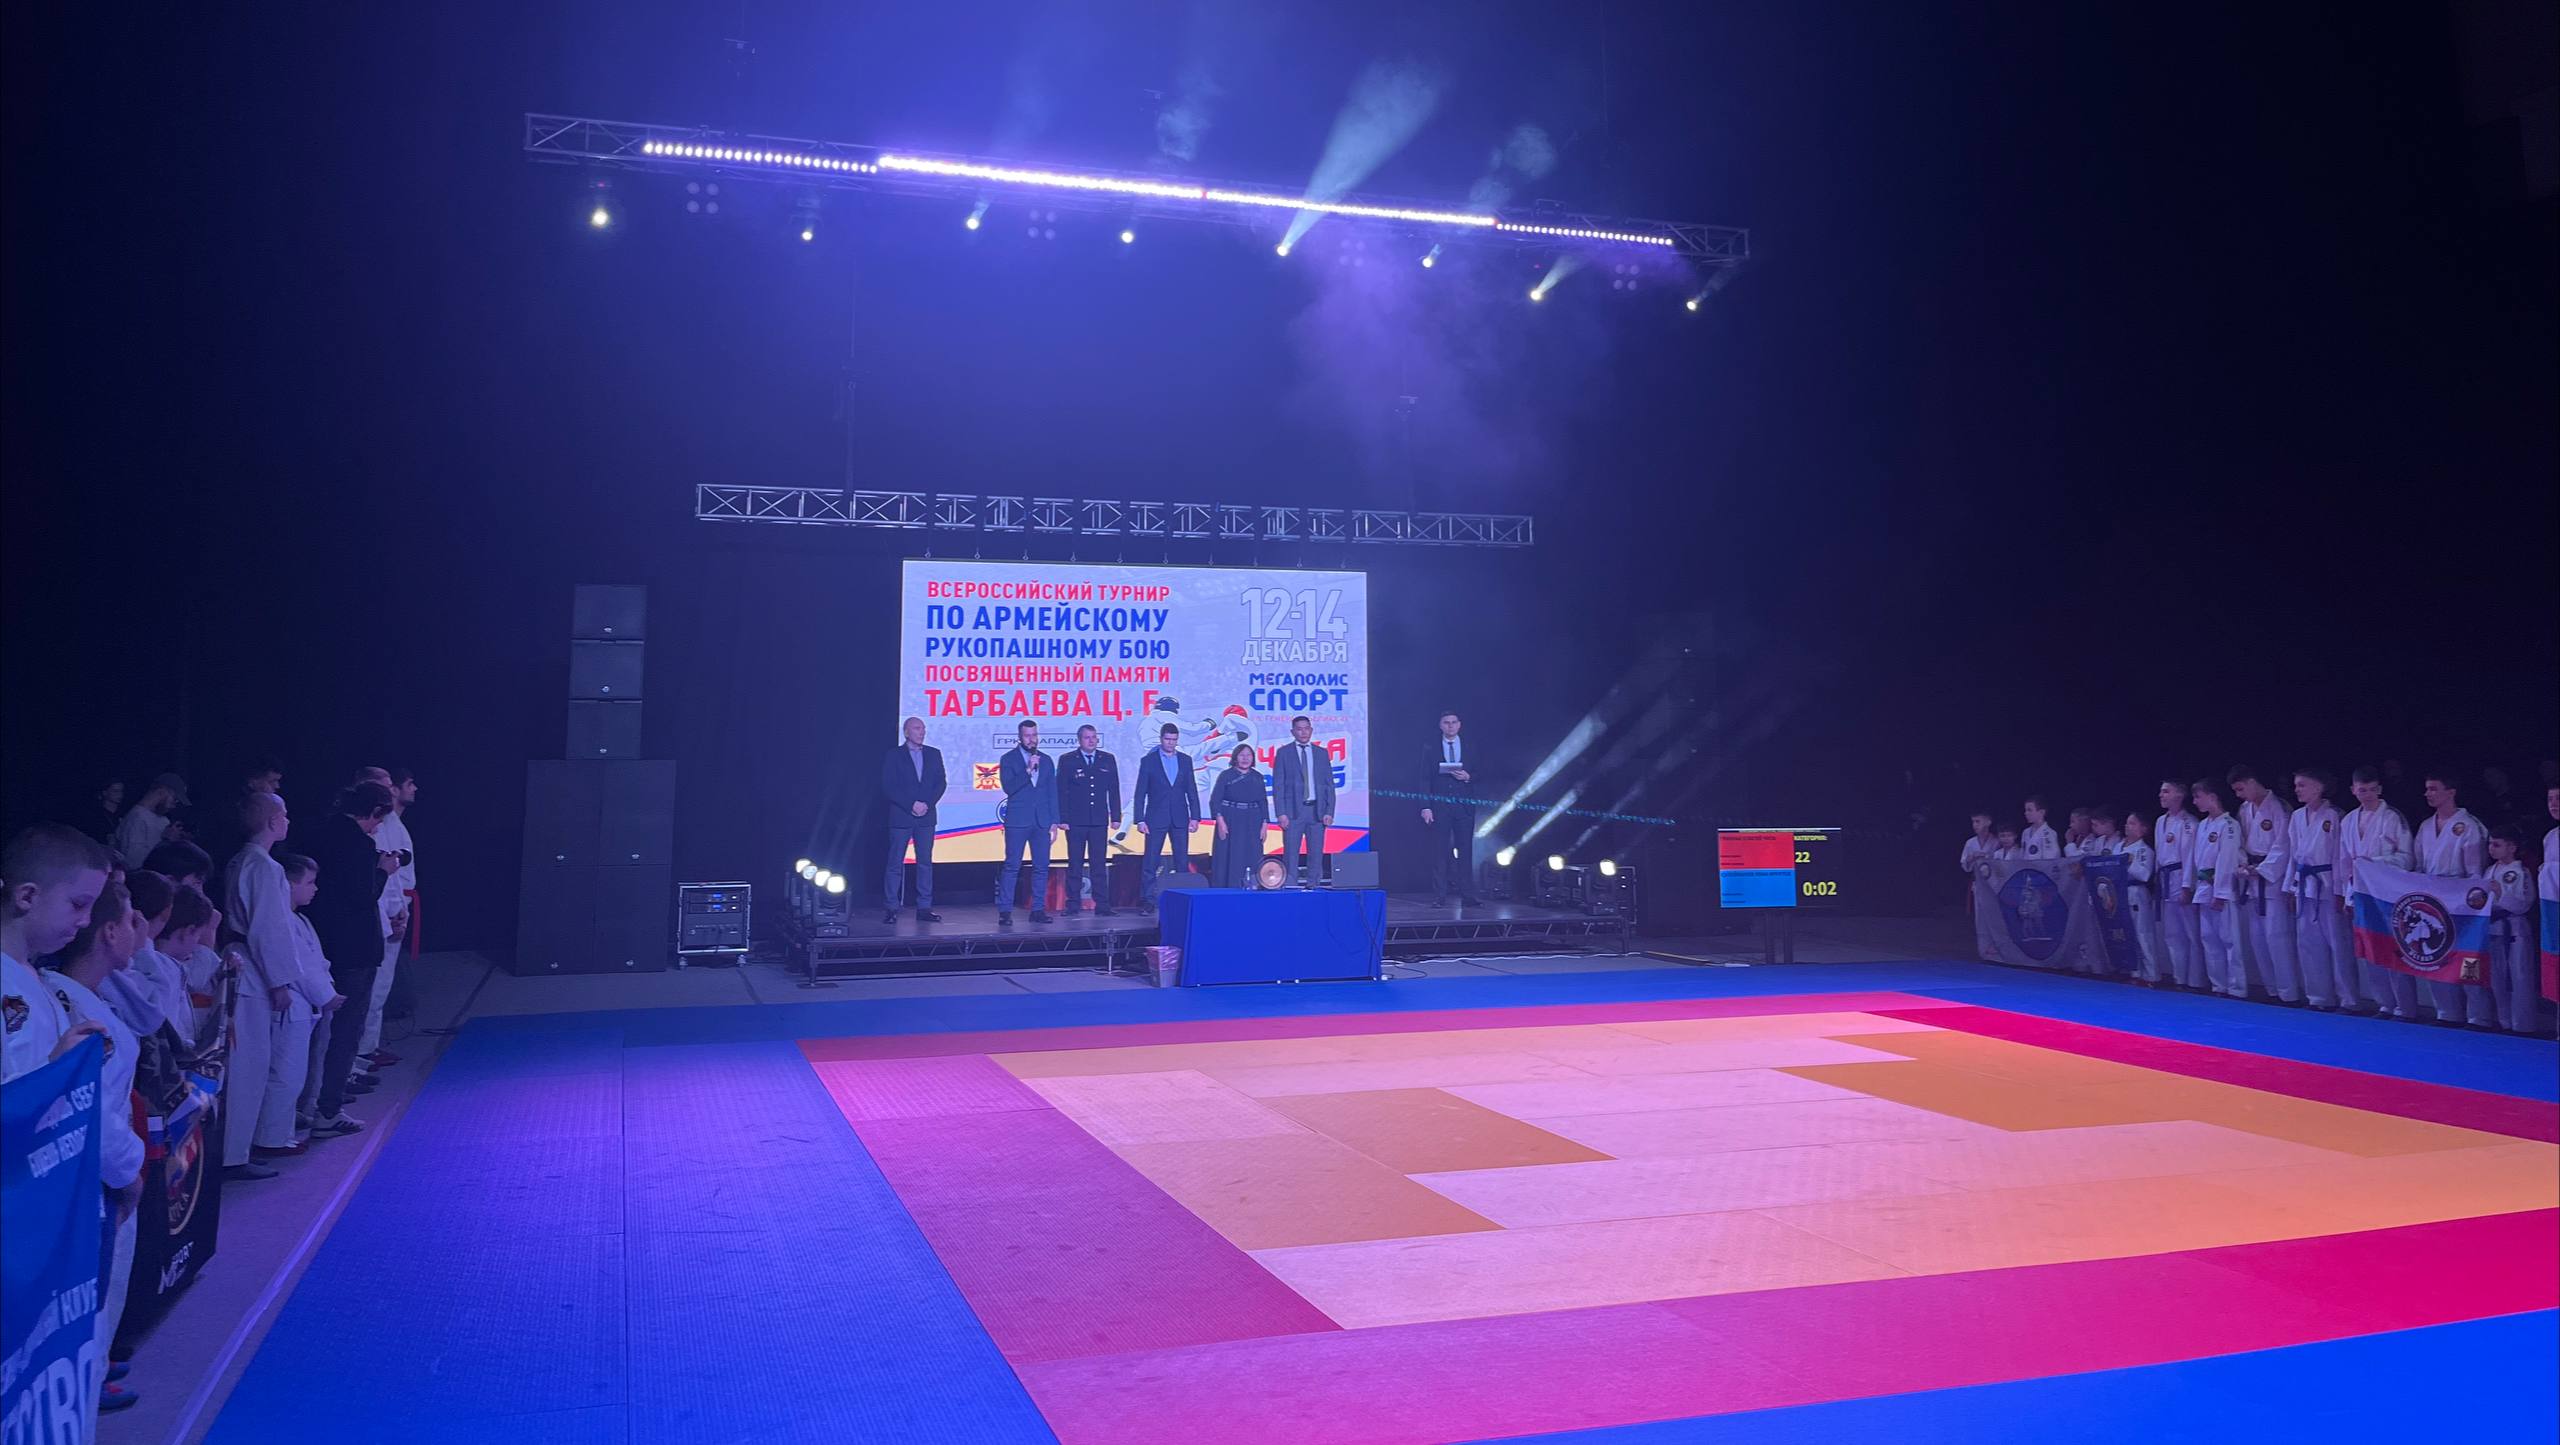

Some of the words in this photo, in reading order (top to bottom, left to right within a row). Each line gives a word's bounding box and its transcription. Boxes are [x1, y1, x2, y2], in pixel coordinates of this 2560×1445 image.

[928, 580, 1092, 600] ВСЕРОССИЙСКИЙ
[1098, 585, 1170, 601] ТУРНИР
[927, 604, 964, 630] ПО
[972, 602, 1169, 632] АРМЕЙСКОМУ
[1241, 588, 1348, 640] 12-14
[926, 637, 1112, 658] РУКОПАШНОМУ
[1119, 639, 1170, 659] БОЮ
[1241, 640, 1348, 666] ДЕКАБРЯ
[926, 663, 1084, 684] ПОСВЯЩЕННЫЙ
[1091, 666, 1170, 683] ПАМЯТИ
[1249, 673, 1348, 686] МЕГАПОЛИС
[924, 689, 1092, 716] ТАРБАЕВА
[1103, 689, 1133, 721] Ц.
[1249, 688, 1348, 711] СПОРТ
[1795, 852, 1811, 863] 22
[1803, 882, 1837, 896] 0:02
